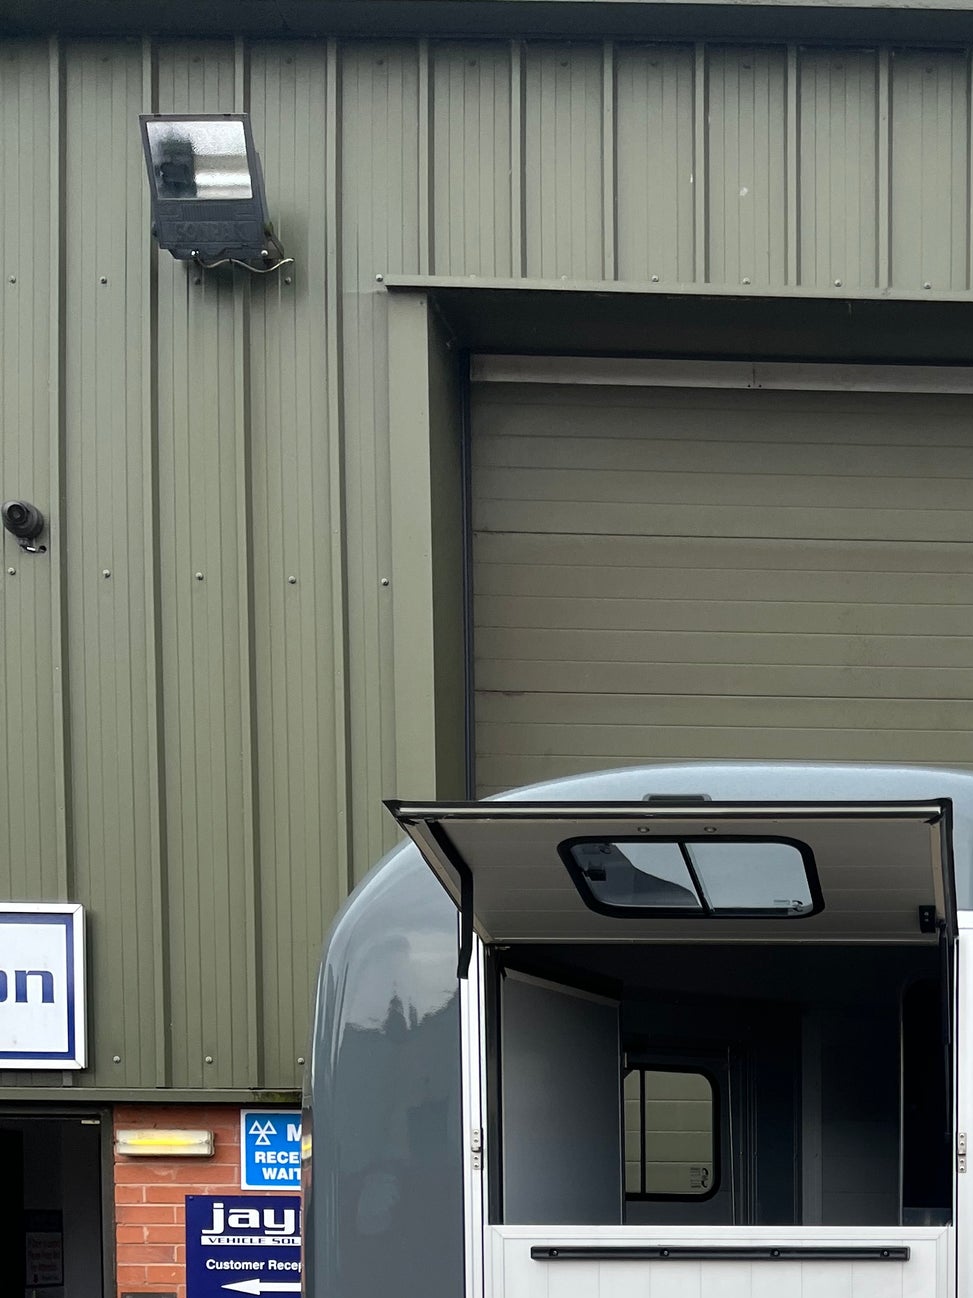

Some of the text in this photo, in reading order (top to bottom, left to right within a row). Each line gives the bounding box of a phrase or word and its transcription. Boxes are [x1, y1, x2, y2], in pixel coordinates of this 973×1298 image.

[255, 1151, 302, 1164] RECE
[202, 1202, 302, 1235] jay
[206, 1259, 265, 1271] Customer
